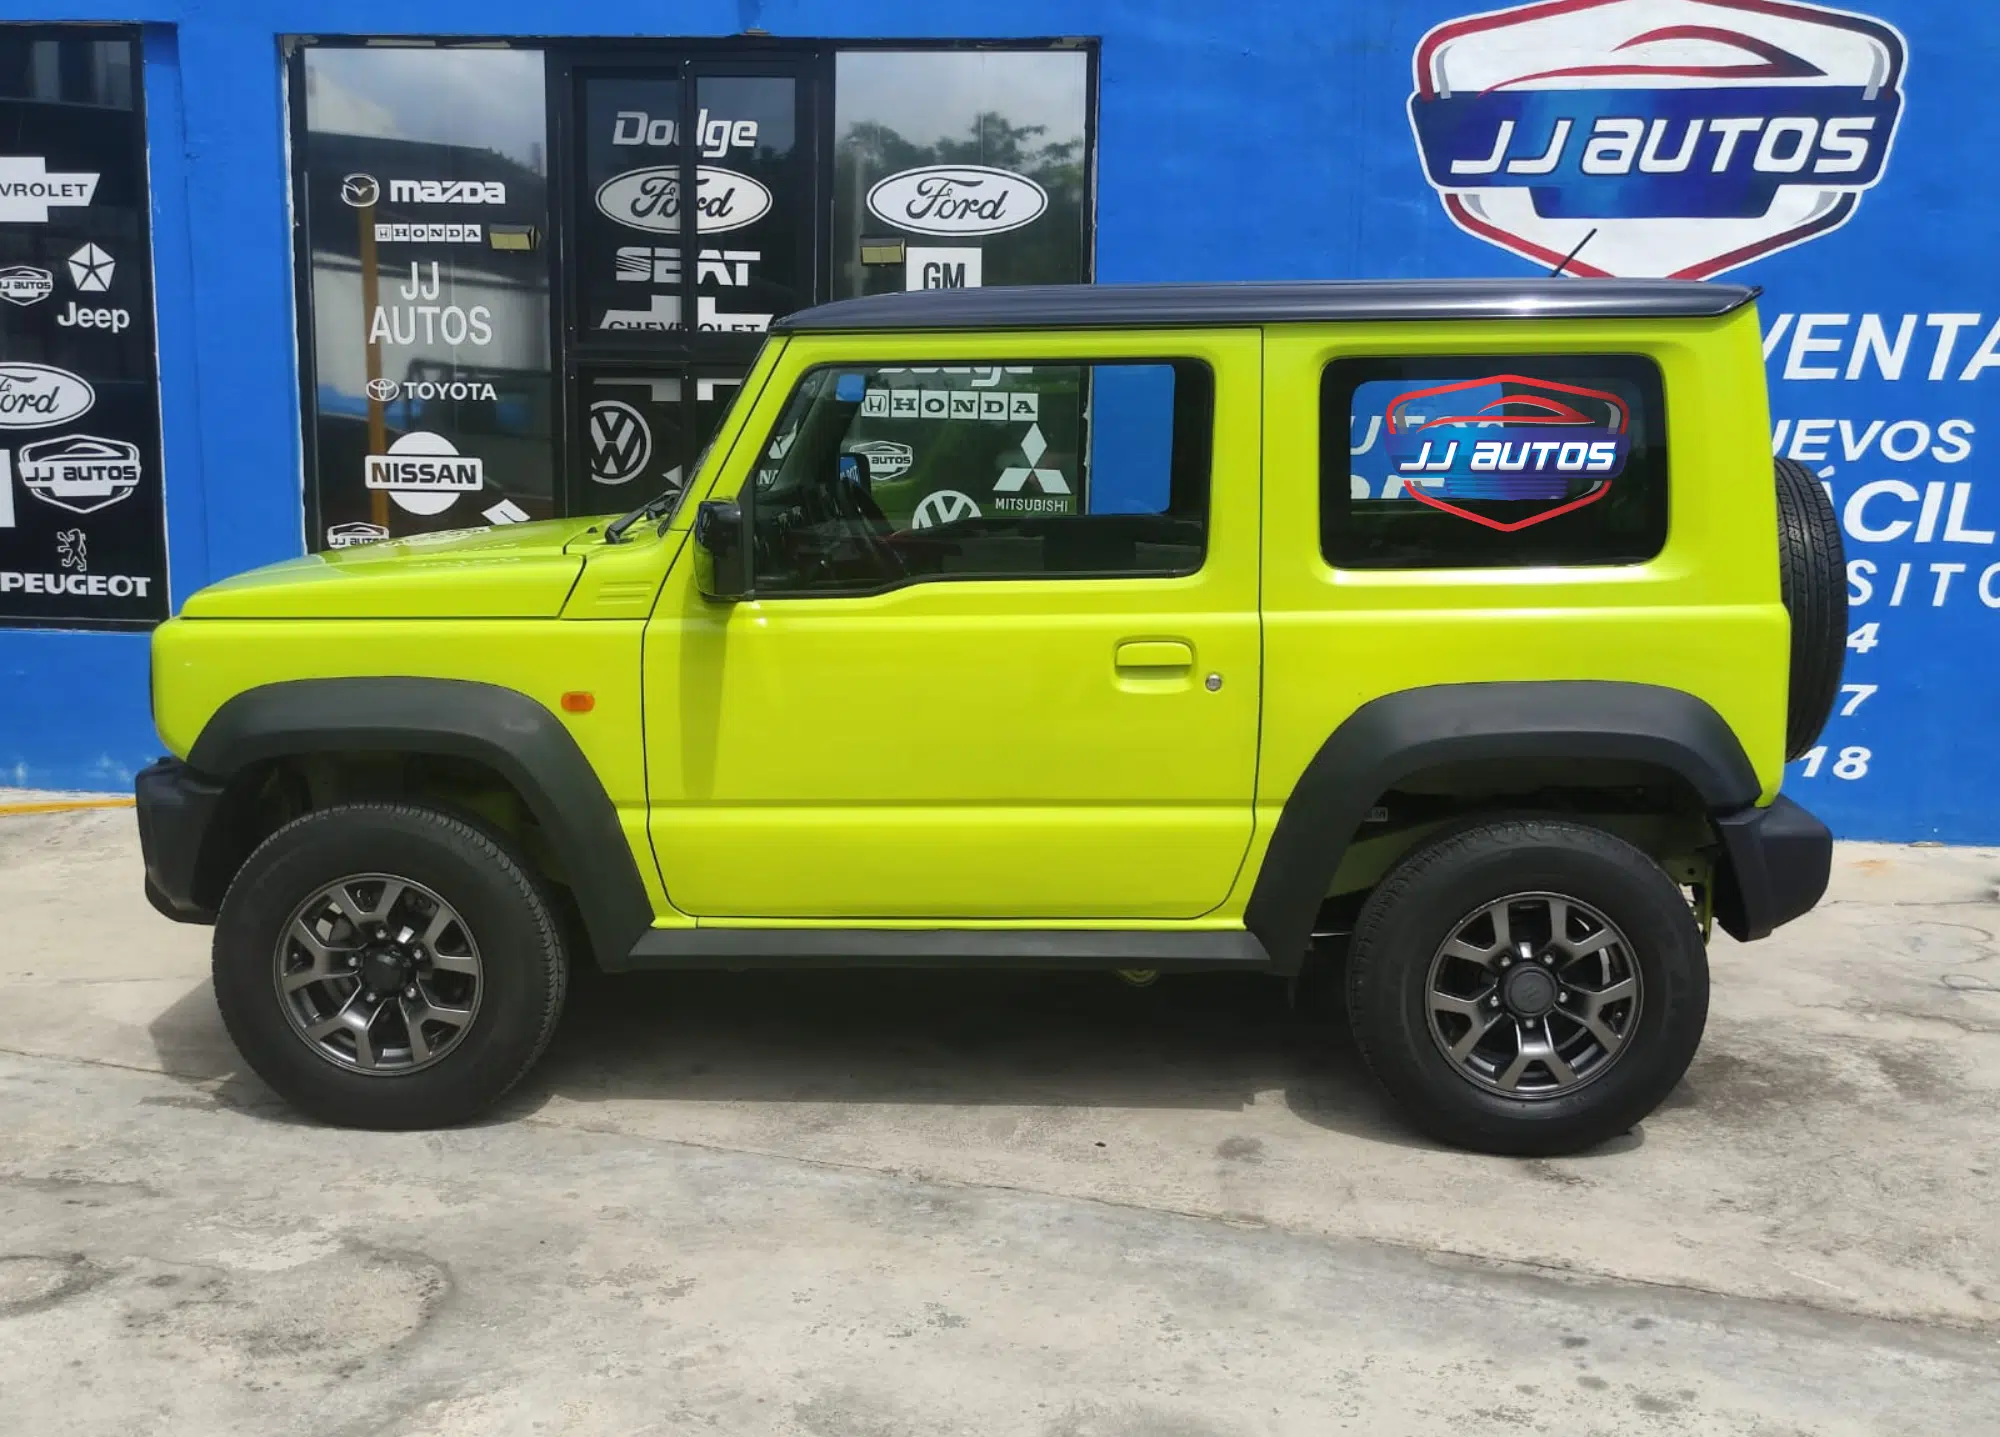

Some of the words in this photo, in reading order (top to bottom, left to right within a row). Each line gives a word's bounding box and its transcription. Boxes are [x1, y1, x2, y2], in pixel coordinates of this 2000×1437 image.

[1450, 119, 1573, 175] JJ
[906, 177, 1009, 219] Ford
[393, 226, 481, 239] HONDA
[616, 247, 760, 286] SEAT
[923, 262, 965, 289] GM
[400, 261, 439, 301] JJ
[57, 301, 130, 333] Jeep
[369, 305, 492, 345] AUTOS
[404, 381, 497, 401] TOYOTA
[892, 395, 1037, 417] HONDA
[25, 466, 54, 482] JJ
[371, 462, 476, 485] NISSAN
[994, 497, 1069, 513] MITSUBISHI
[0, 571, 151, 598] PEUGEOT
